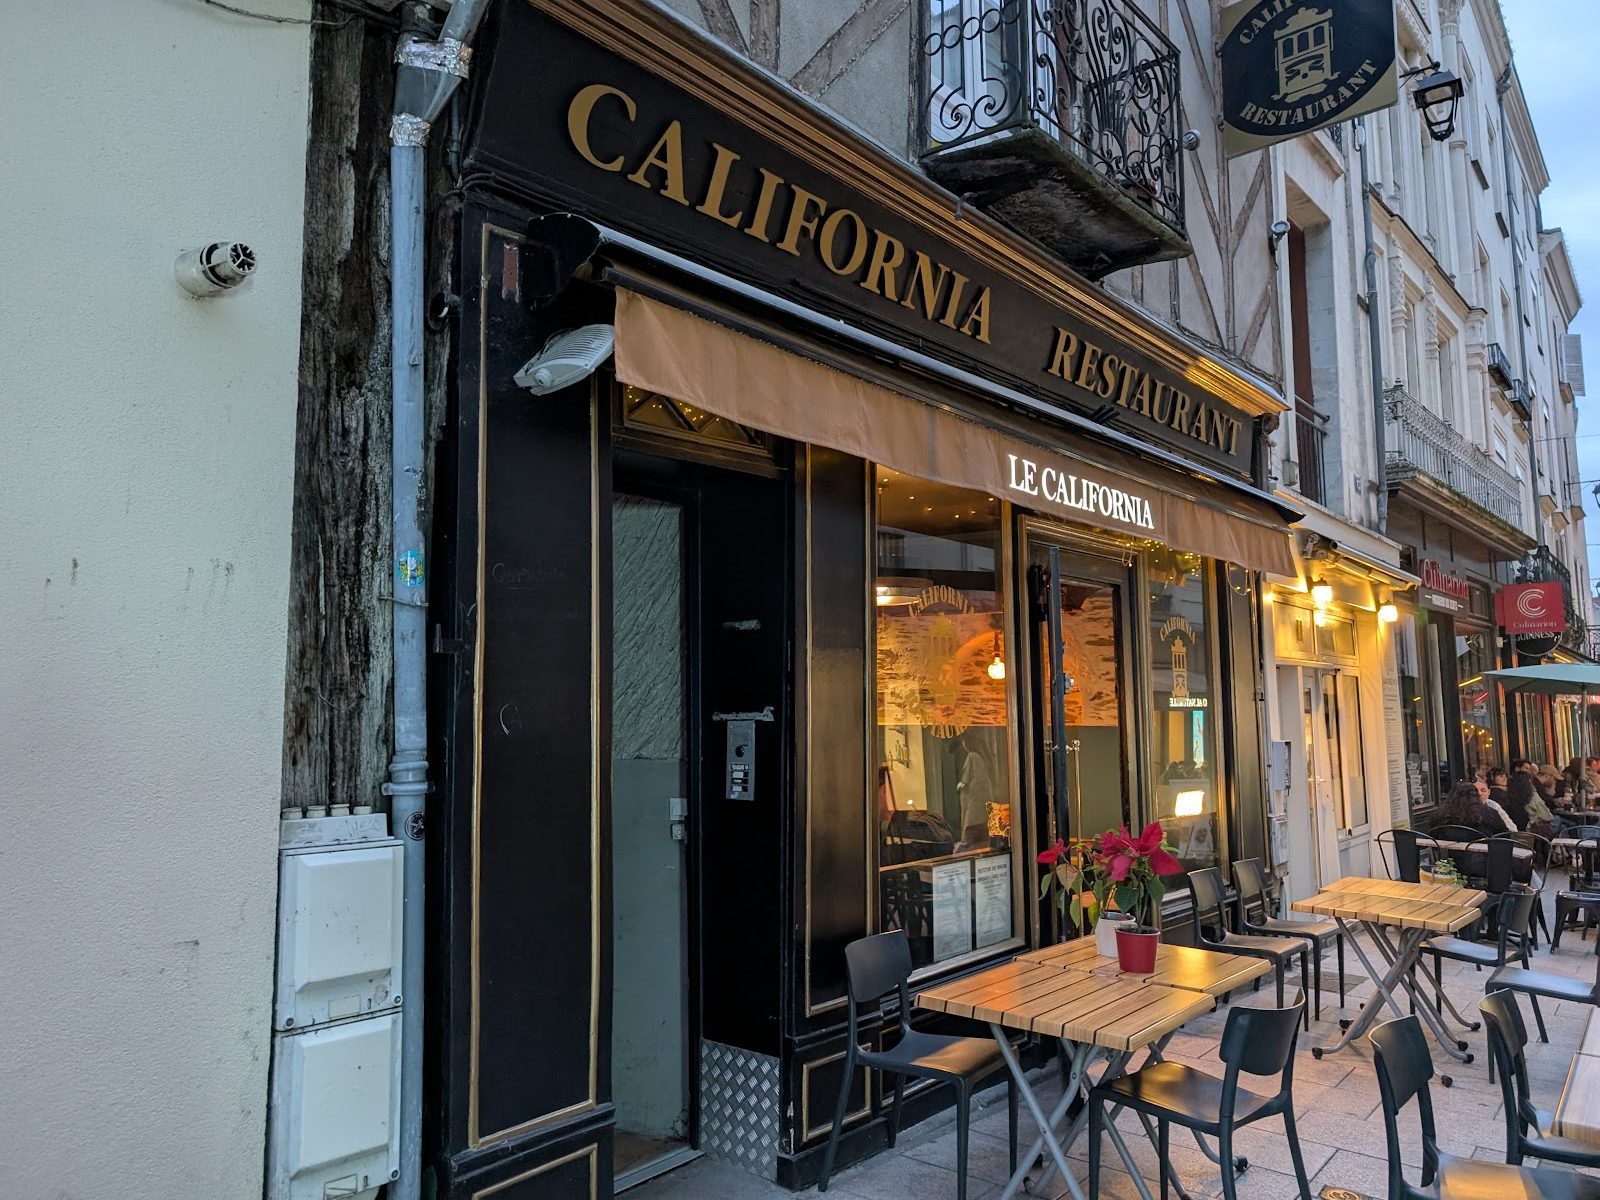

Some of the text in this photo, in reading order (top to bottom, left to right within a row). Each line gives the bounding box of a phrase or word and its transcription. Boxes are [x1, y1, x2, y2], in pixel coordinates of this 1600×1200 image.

[1240, 59, 1378, 127] RESTAURANT
[567, 83, 1244, 457] CALIFORNIA RESTAURANT
[1008, 454, 1155, 529] LE CALIFORNIA
[1513, 620, 1557, 629] Culinarion
